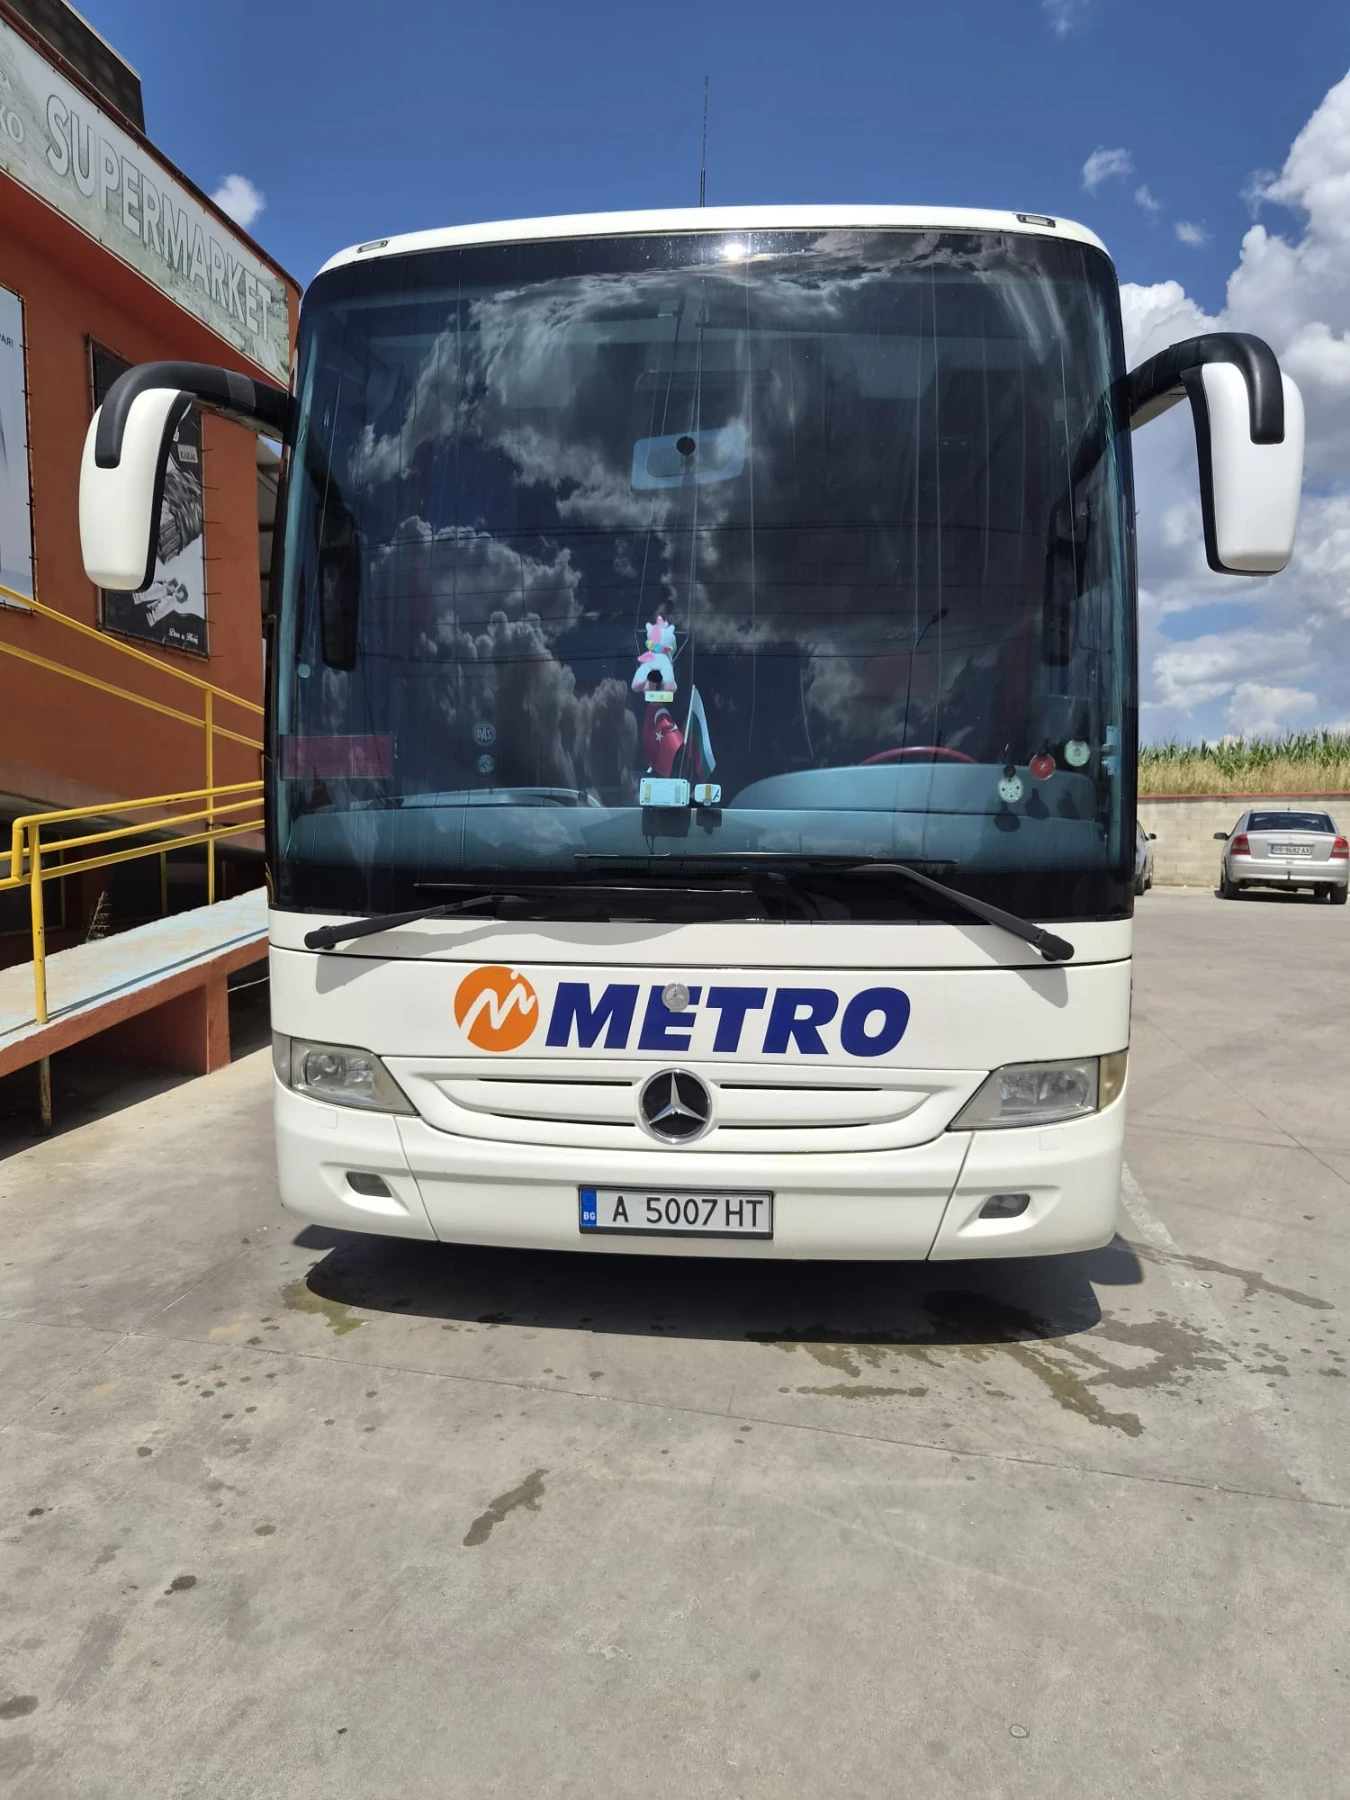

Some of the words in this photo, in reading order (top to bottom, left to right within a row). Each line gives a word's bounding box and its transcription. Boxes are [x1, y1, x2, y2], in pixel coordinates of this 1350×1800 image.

[46, 94, 271, 343] SUPERMARKET
[545, 981, 911, 1057] METRO
[583, 1211, 596, 1221] BG
[612, 1195, 629, 1223] A
[646, 1196, 719, 1226] 5007
[725, 1198, 764, 1228] HT
